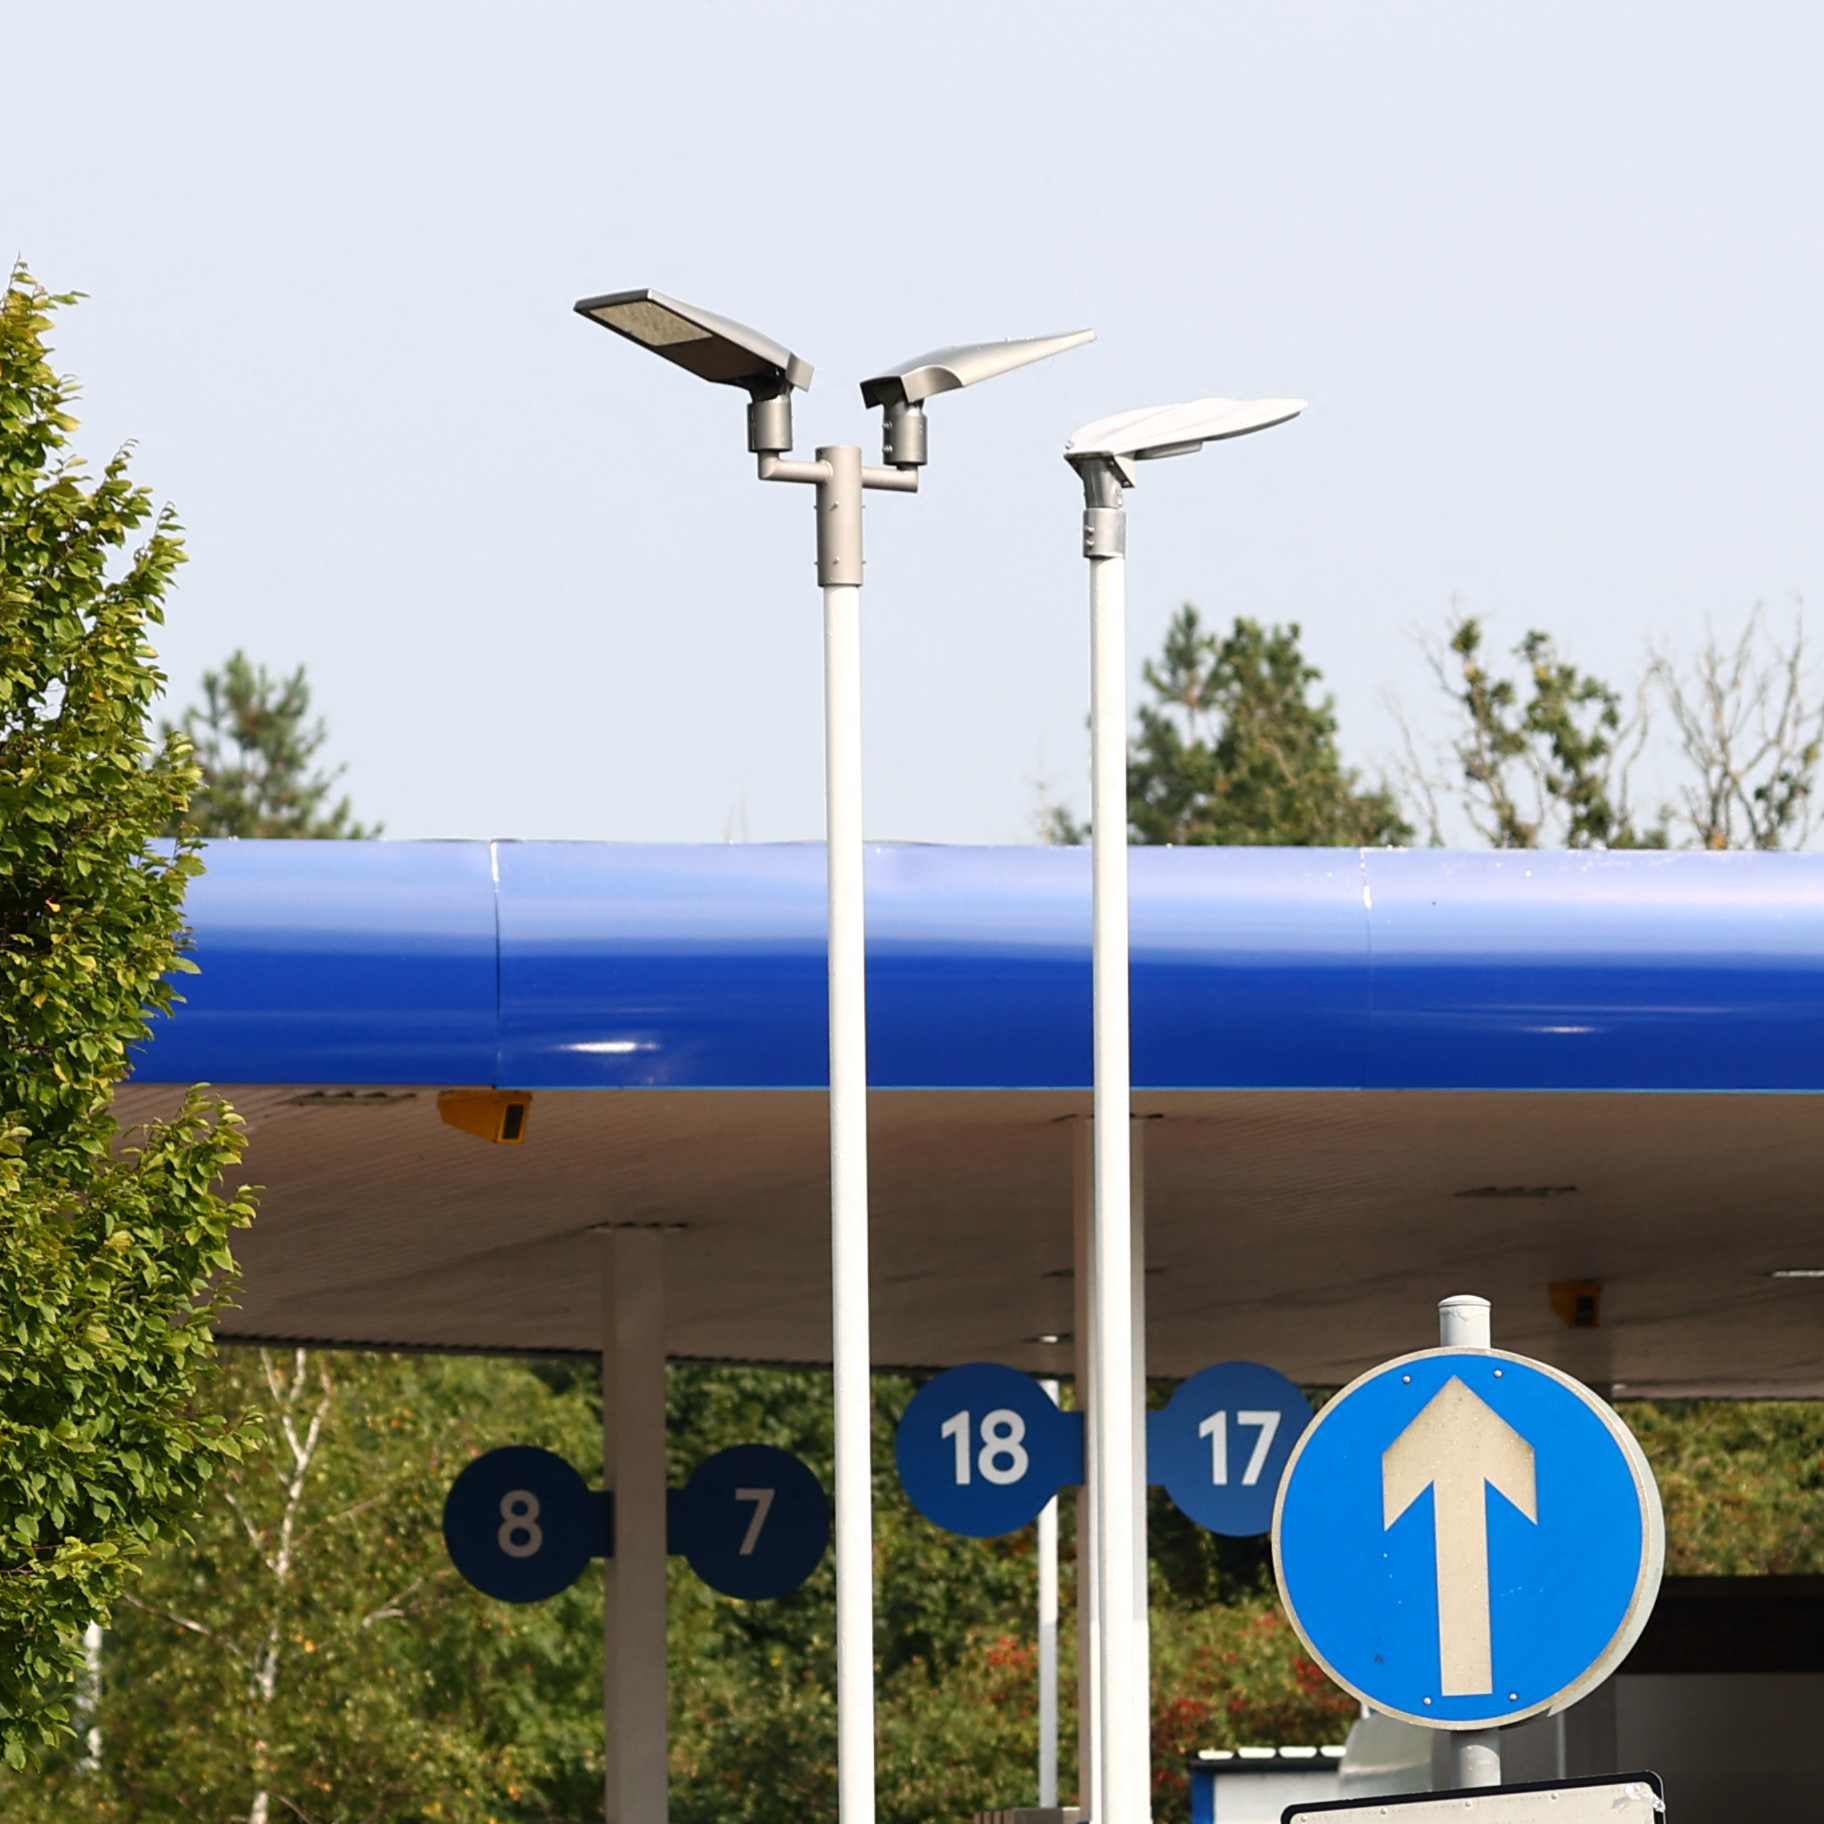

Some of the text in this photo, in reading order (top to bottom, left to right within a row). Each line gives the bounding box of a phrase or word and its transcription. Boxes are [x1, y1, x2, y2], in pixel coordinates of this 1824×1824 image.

[941, 1408, 1029, 1484] 18
[1198, 1409, 1283, 1486] 17
[497, 1490, 543, 1558] 8
[735, 1489, 775, 1555] 7
